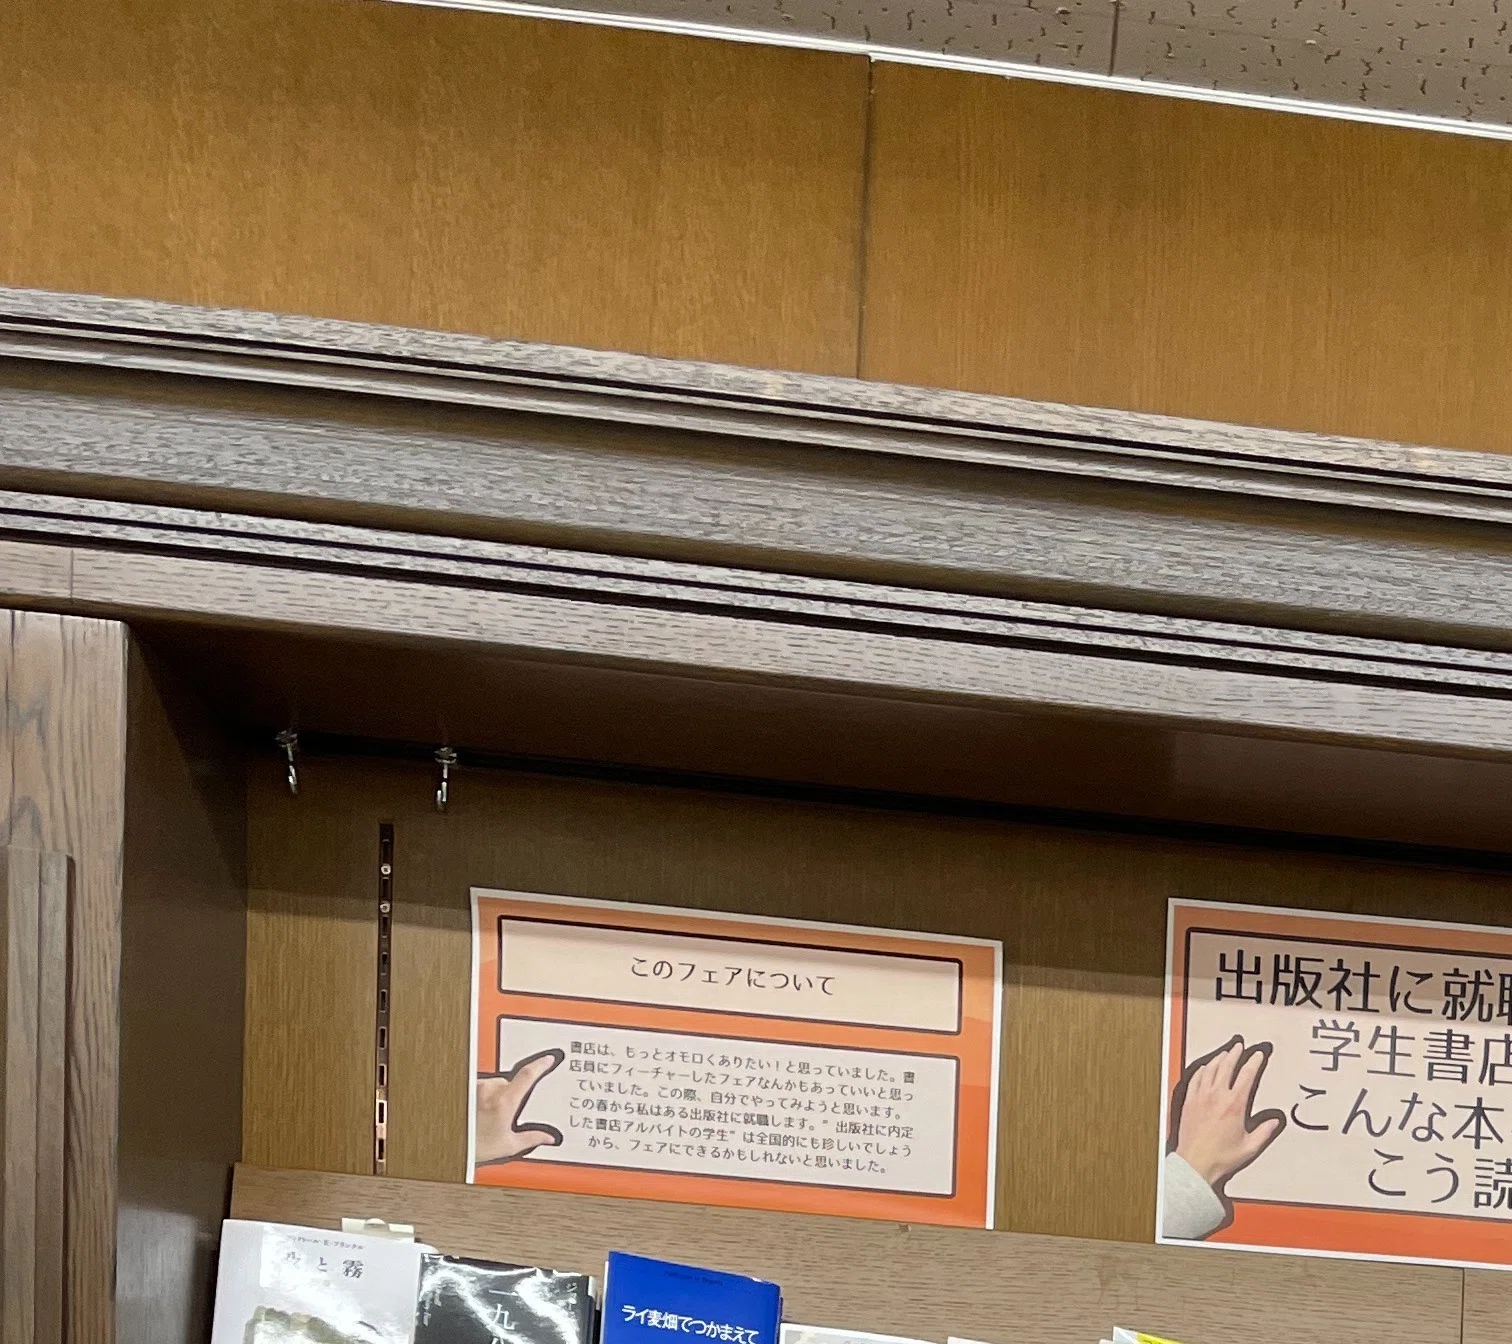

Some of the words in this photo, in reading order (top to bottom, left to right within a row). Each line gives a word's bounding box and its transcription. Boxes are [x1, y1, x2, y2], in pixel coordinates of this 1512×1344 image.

[631, 957, 838, 996] このフェアについて
